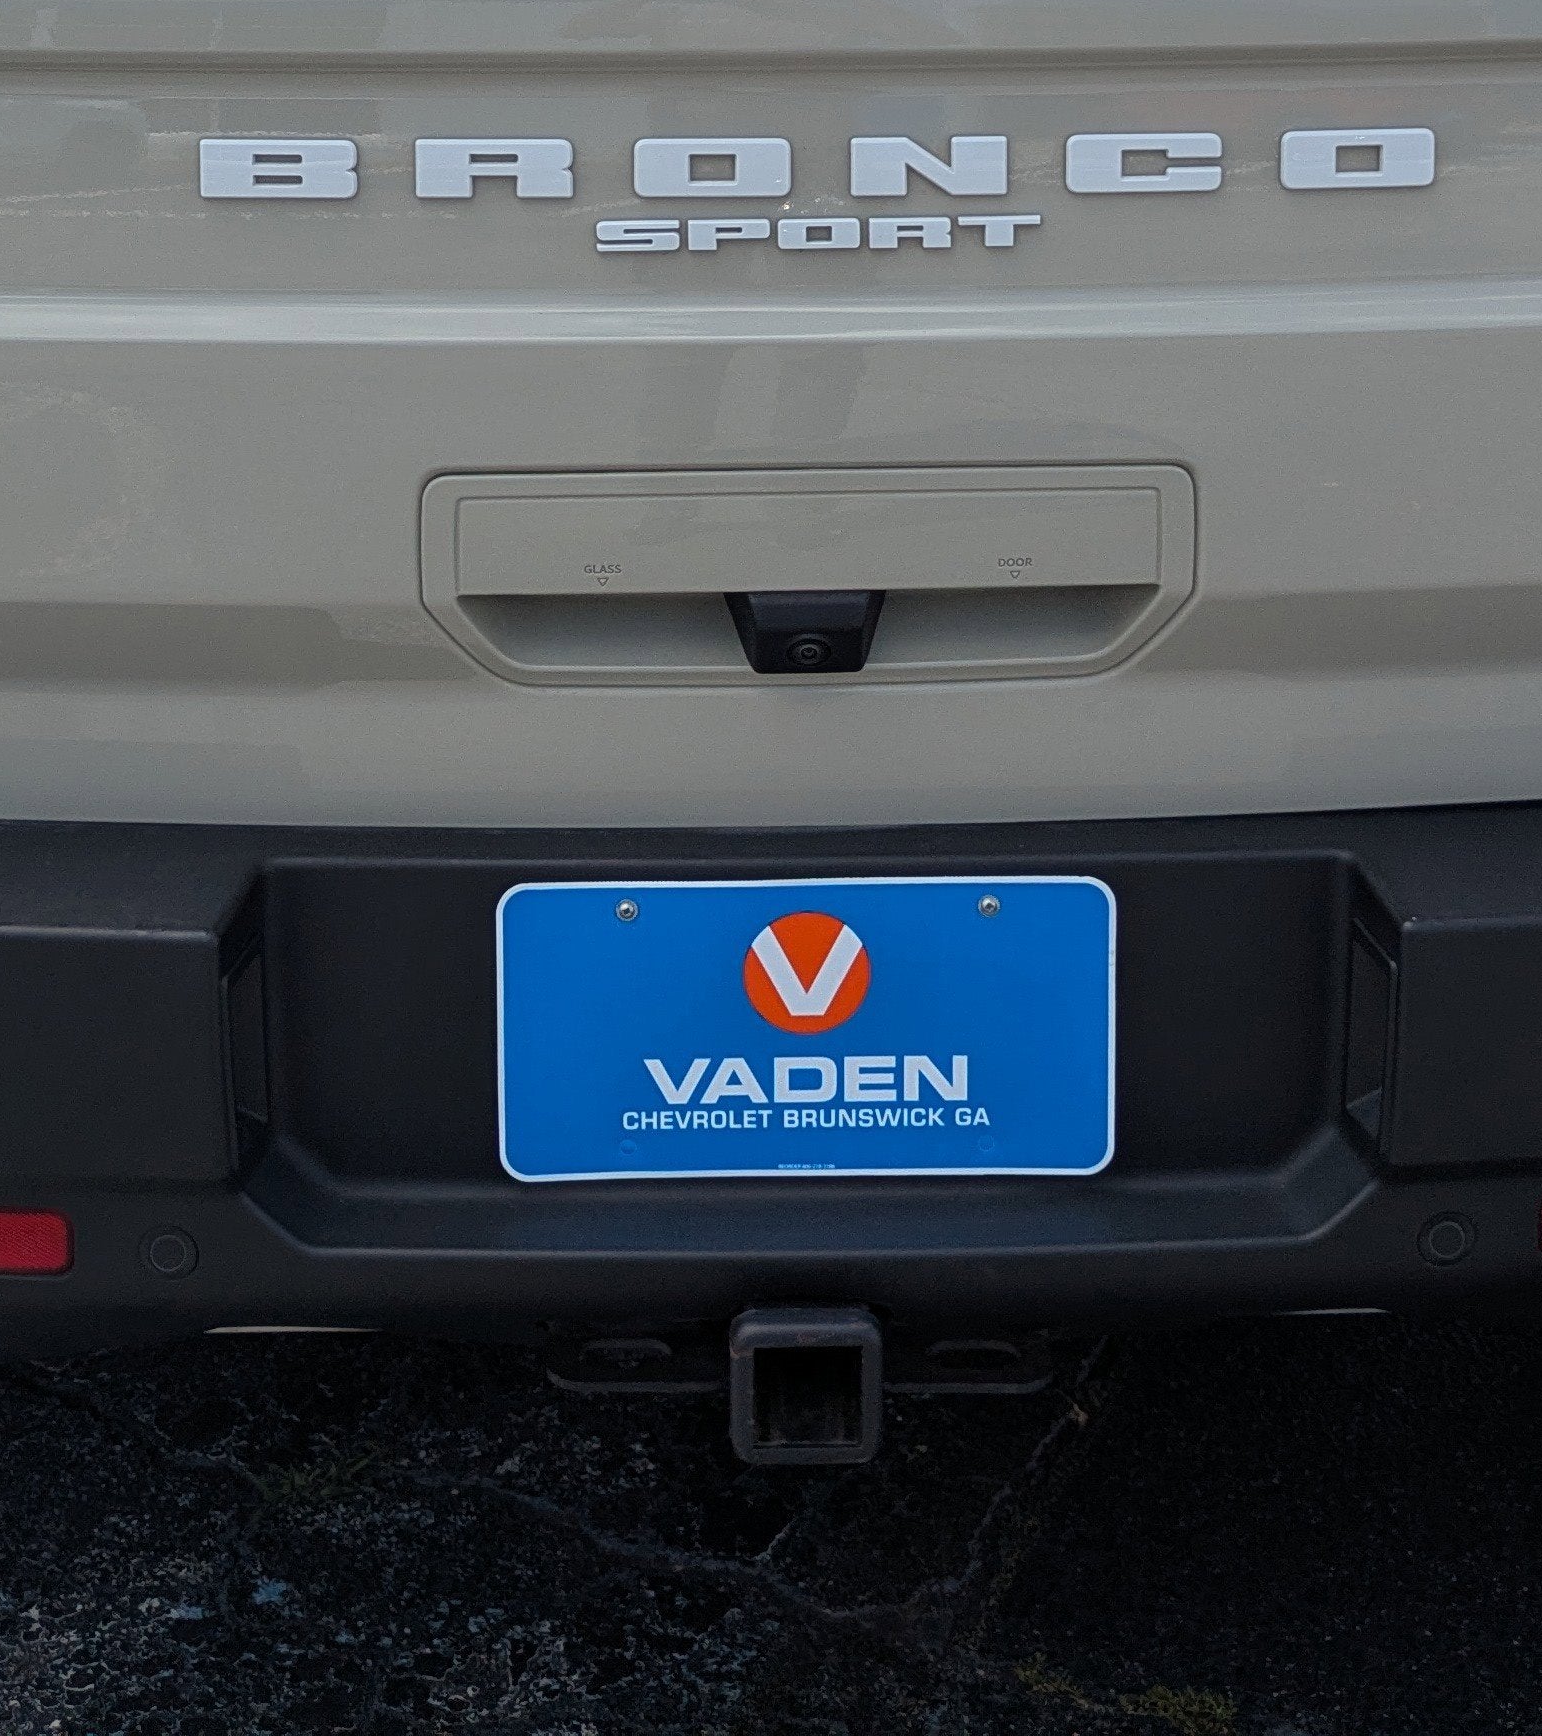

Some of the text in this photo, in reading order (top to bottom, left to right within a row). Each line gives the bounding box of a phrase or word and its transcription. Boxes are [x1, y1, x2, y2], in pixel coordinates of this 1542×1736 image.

[199, 127, 1436, 200] BRONCO
[595, 214, 1042, 252] SPORT
[583, 564, 622, 574] GLASS
[997, 557, 1033, 567] DOOR
[750, 924, 863, 1017] V
[643, 1055, 968, 1105] VADEN
[622, 1107, 990, 1131] CHEVROLET BRUNSWICK GA
